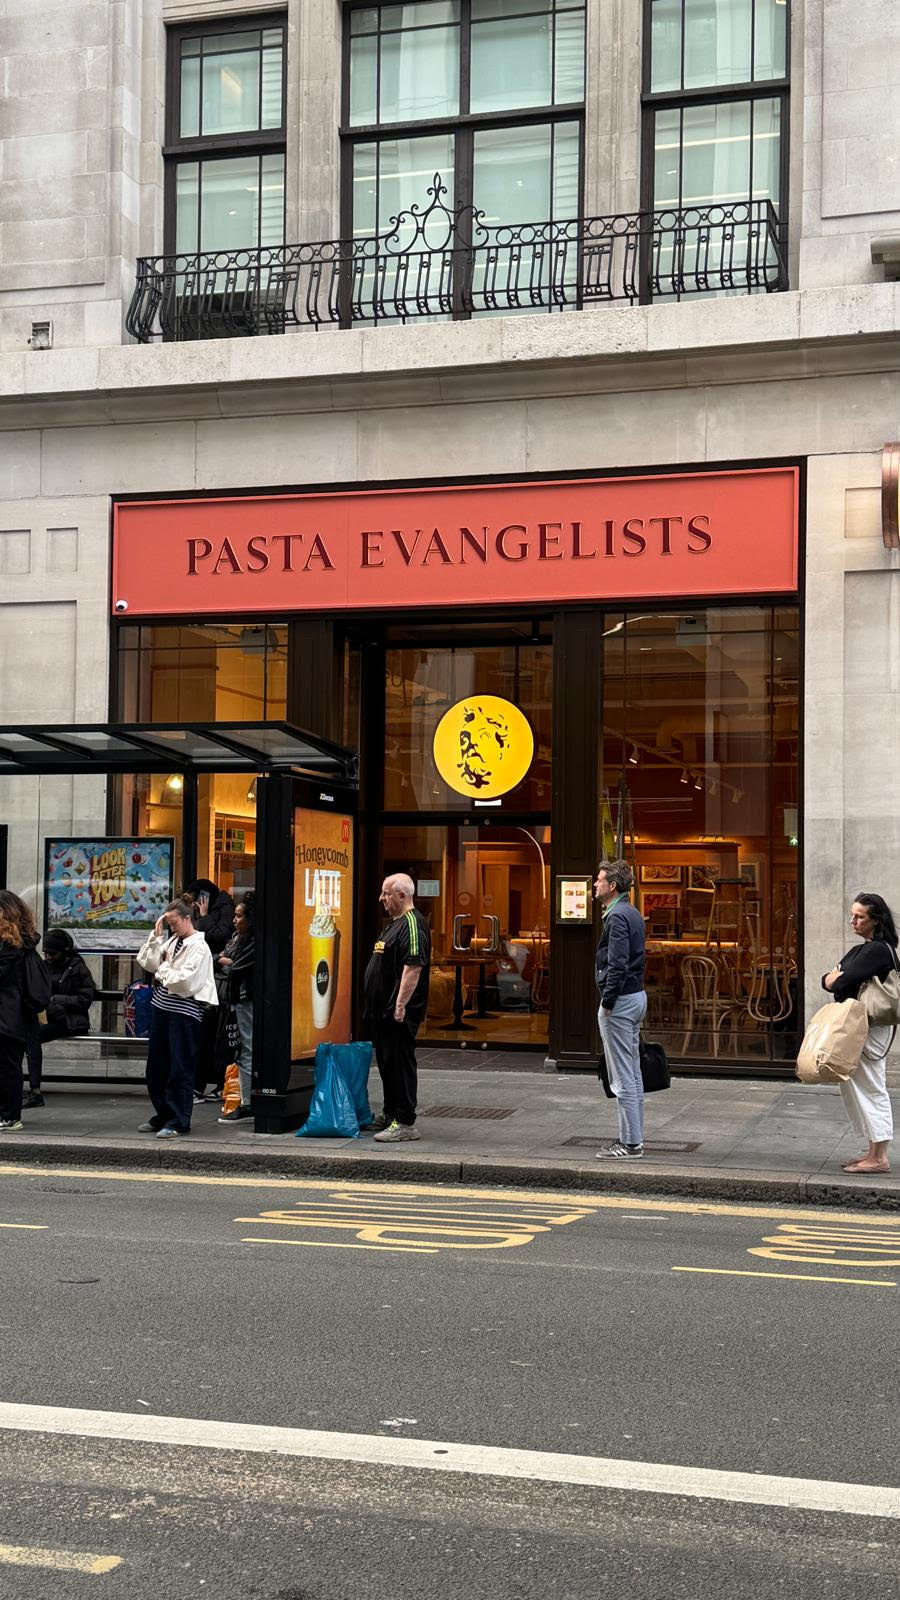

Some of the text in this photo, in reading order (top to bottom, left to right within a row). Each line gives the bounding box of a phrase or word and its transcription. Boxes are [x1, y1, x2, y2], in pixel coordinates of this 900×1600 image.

[186, 514, 713, 576] PASTA EVANGELISTS
[92, 848, 127, 873] LOOK
[296, 844, 349, 869] Honeycomb
[92, 864, 126, 883] AFTER
[91, 876, 126, 905] YOU
[304, 868, 341, 908] LATTE
